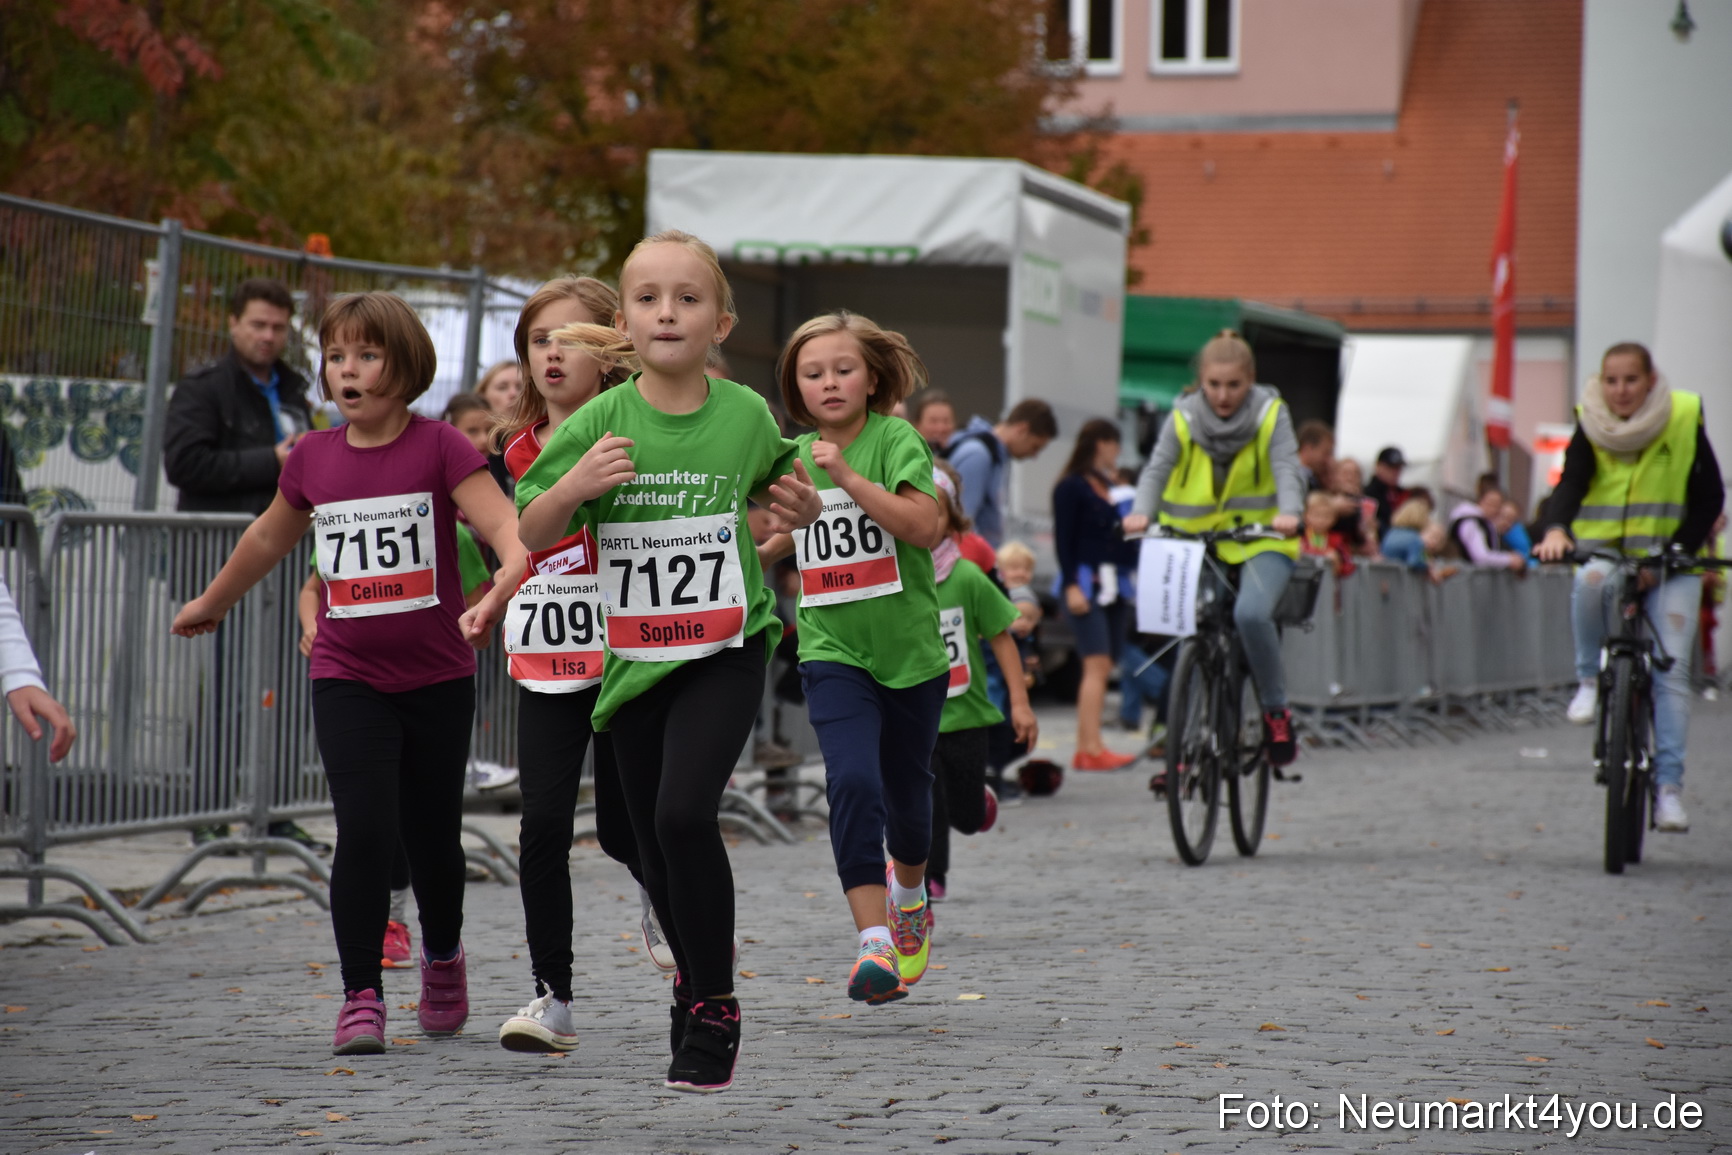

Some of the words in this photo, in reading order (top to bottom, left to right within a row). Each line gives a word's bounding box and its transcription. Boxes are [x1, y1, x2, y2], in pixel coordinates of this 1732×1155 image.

[317, 513, 351, 528] PARTL
[353, 507, 412, 523] Neumarkt
[600, 537, 639, 551] PARTL
[642, 532, 712, 549] Neumarkt
[798, 512, 883, 563] 7036
[325, 523, 421, 574] 7151
[548, 556, 569, 574] DEHN
[609, 551, 725, 609] 7127
[821, 571, 855, 589] Mira
[351, 582, 404, 601] Celina
[518, 584, 544, 596] ARTL
[731, 595, 738, 605] K
[606, 608, 613, 616] 3
[639, 620, 705, 646] Sophie
[508, 644, 514, 653] 3
[552, 658, 586, 676] Lisa
